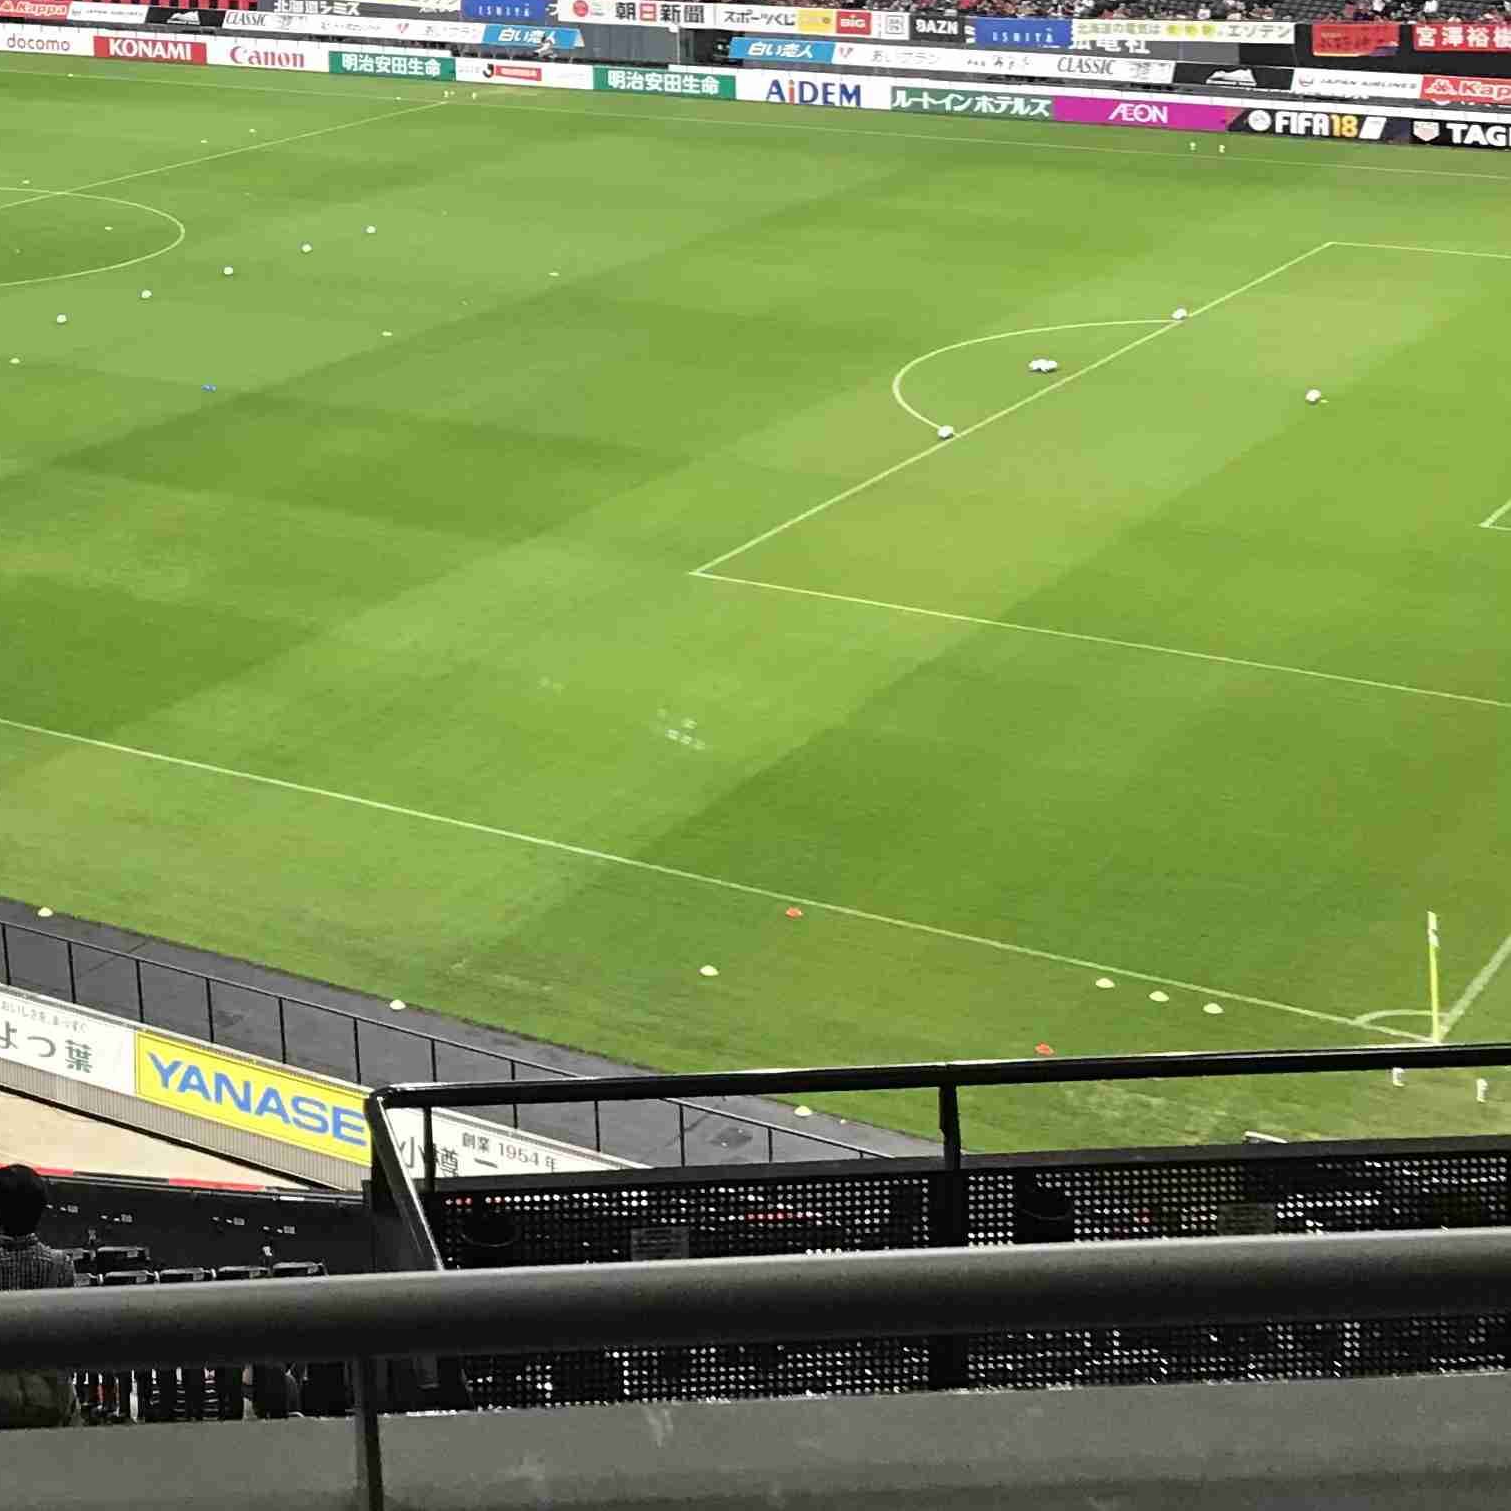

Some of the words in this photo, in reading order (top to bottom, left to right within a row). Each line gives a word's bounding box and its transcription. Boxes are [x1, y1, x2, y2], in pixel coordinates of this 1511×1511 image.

[16, 0, 68, 17] Kappa
[226, 11, 267, 27] CLASSIC
[615, 1, 706, 25] 朝日新聞
[724, 8, 796, 26] スポーツくじ
[6, 35, 71, 52] docomo
[109, 38, 193, 61] KONAMI
[747, 41, 814, 59] 白い恋人
[230, 45, 305, 68] Canon
[342, 52, 441, 77] 明治安田生命
[1057, 56, 1115, 76] CLASSIC
[607, 70, 721, 95] 明治安田生命
[892, 89, 1053, 118] ルートインホテルズ
[1446, 122, 1511, 147] TAG
[146, 1051, 367, 1148] YANASE
[497, 1141, 539, 1166] 1954
